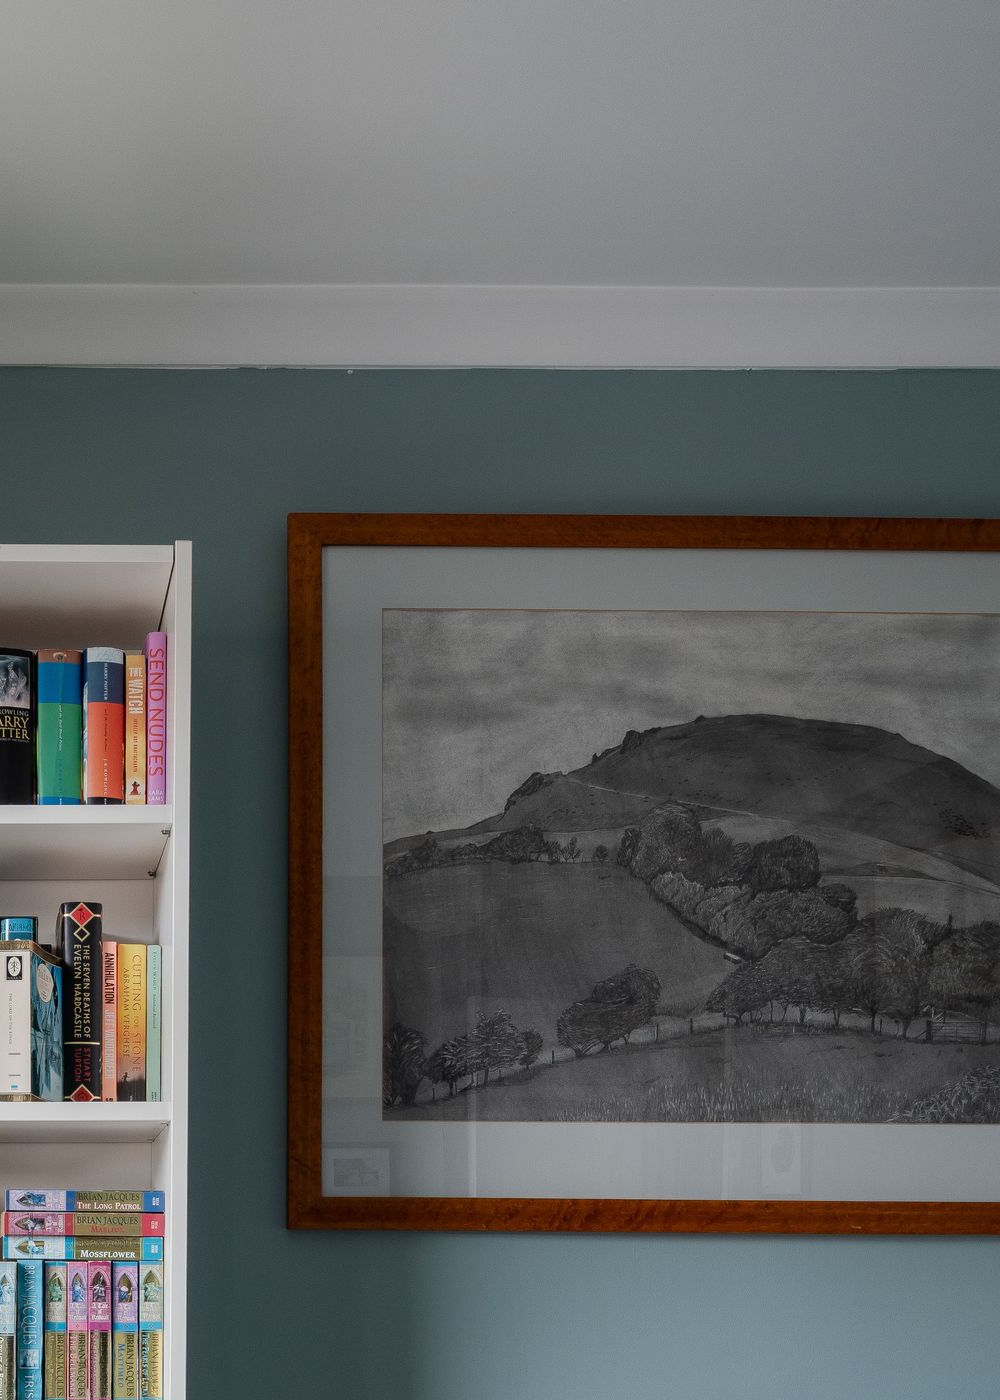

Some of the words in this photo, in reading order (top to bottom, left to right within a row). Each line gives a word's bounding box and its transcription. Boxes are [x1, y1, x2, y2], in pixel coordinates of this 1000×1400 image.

[149, 648, 164, 701] SEND
[149, 708, 164, 776] NUDES
[74, 944, 82, 980] EVELYN
[104, 952, 114, 1004] ANNIHILATION
[74, 984, 82, 1038] HARDCASTLE
[84, 1026, 90, 1038] OF
[116, 1202, 140, 1210] PATROL
[80, 1250, 136, 1258] MOSSFLOWER
[24, 1265, 36, 1292] BRIAN
[22, 1296, 36, 1344] JACQUES
